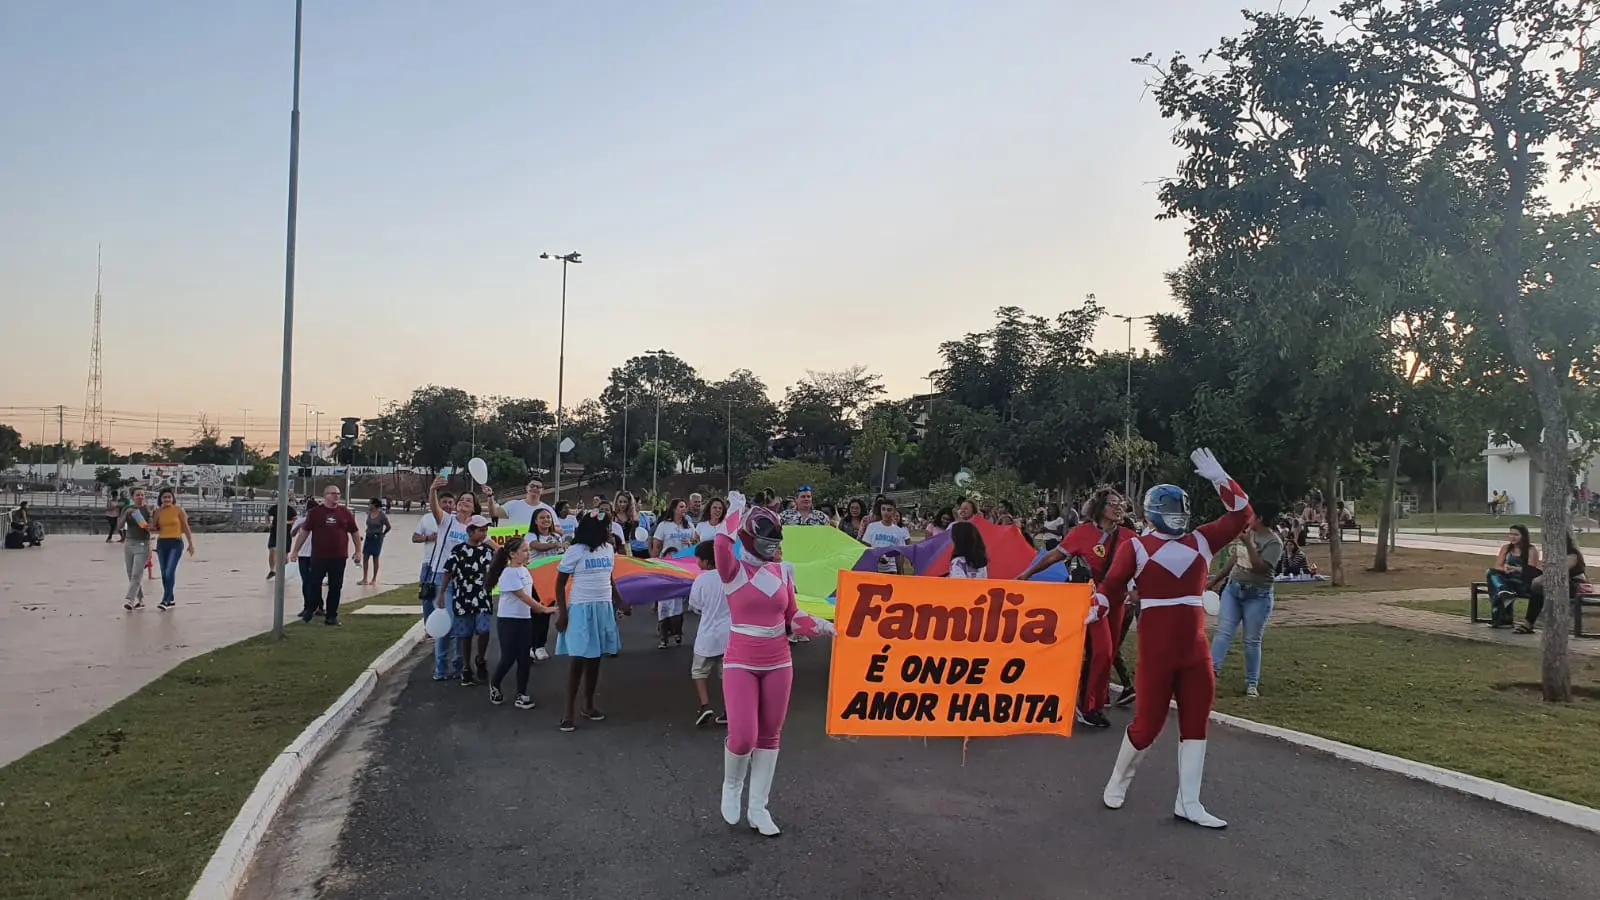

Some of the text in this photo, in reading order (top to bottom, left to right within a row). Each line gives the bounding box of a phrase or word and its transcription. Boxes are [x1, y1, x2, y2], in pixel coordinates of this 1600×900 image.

[845, 583, 1059, 645] Família
[865, 643, 1026, 686] É ONDE O
[840, 690, 939, 722] AMOR
